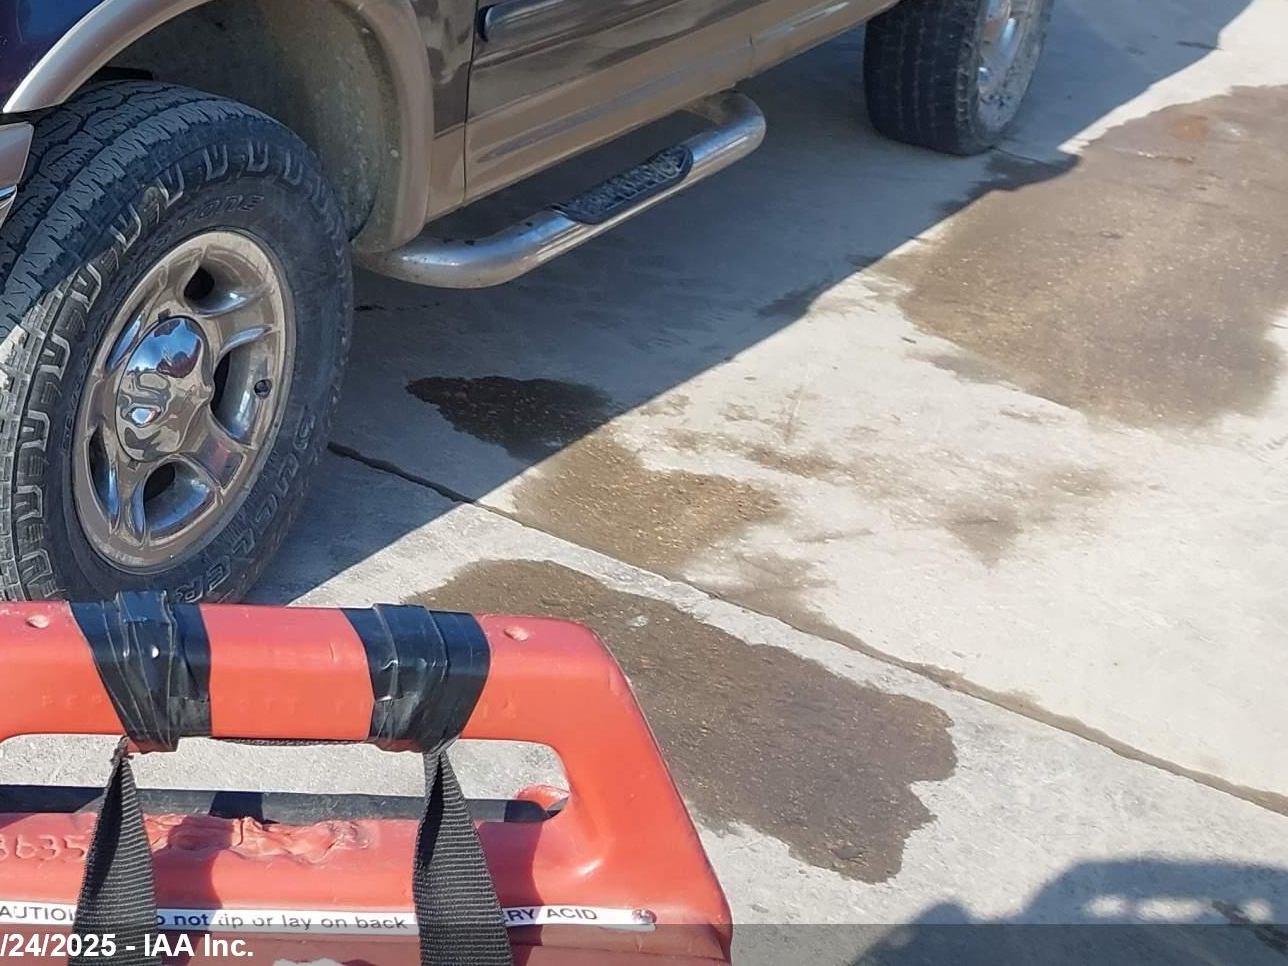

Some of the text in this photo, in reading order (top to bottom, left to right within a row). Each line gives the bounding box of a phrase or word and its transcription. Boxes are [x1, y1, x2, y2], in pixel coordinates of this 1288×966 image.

[174, 913, 209, 926] not
[252, 915, 273, 927] or
[282, 914, 312, 930] lay
[321, 917, 348, 928] on
[355, 915, 408, 930] back
[546, 907, 598, 921] ACID
